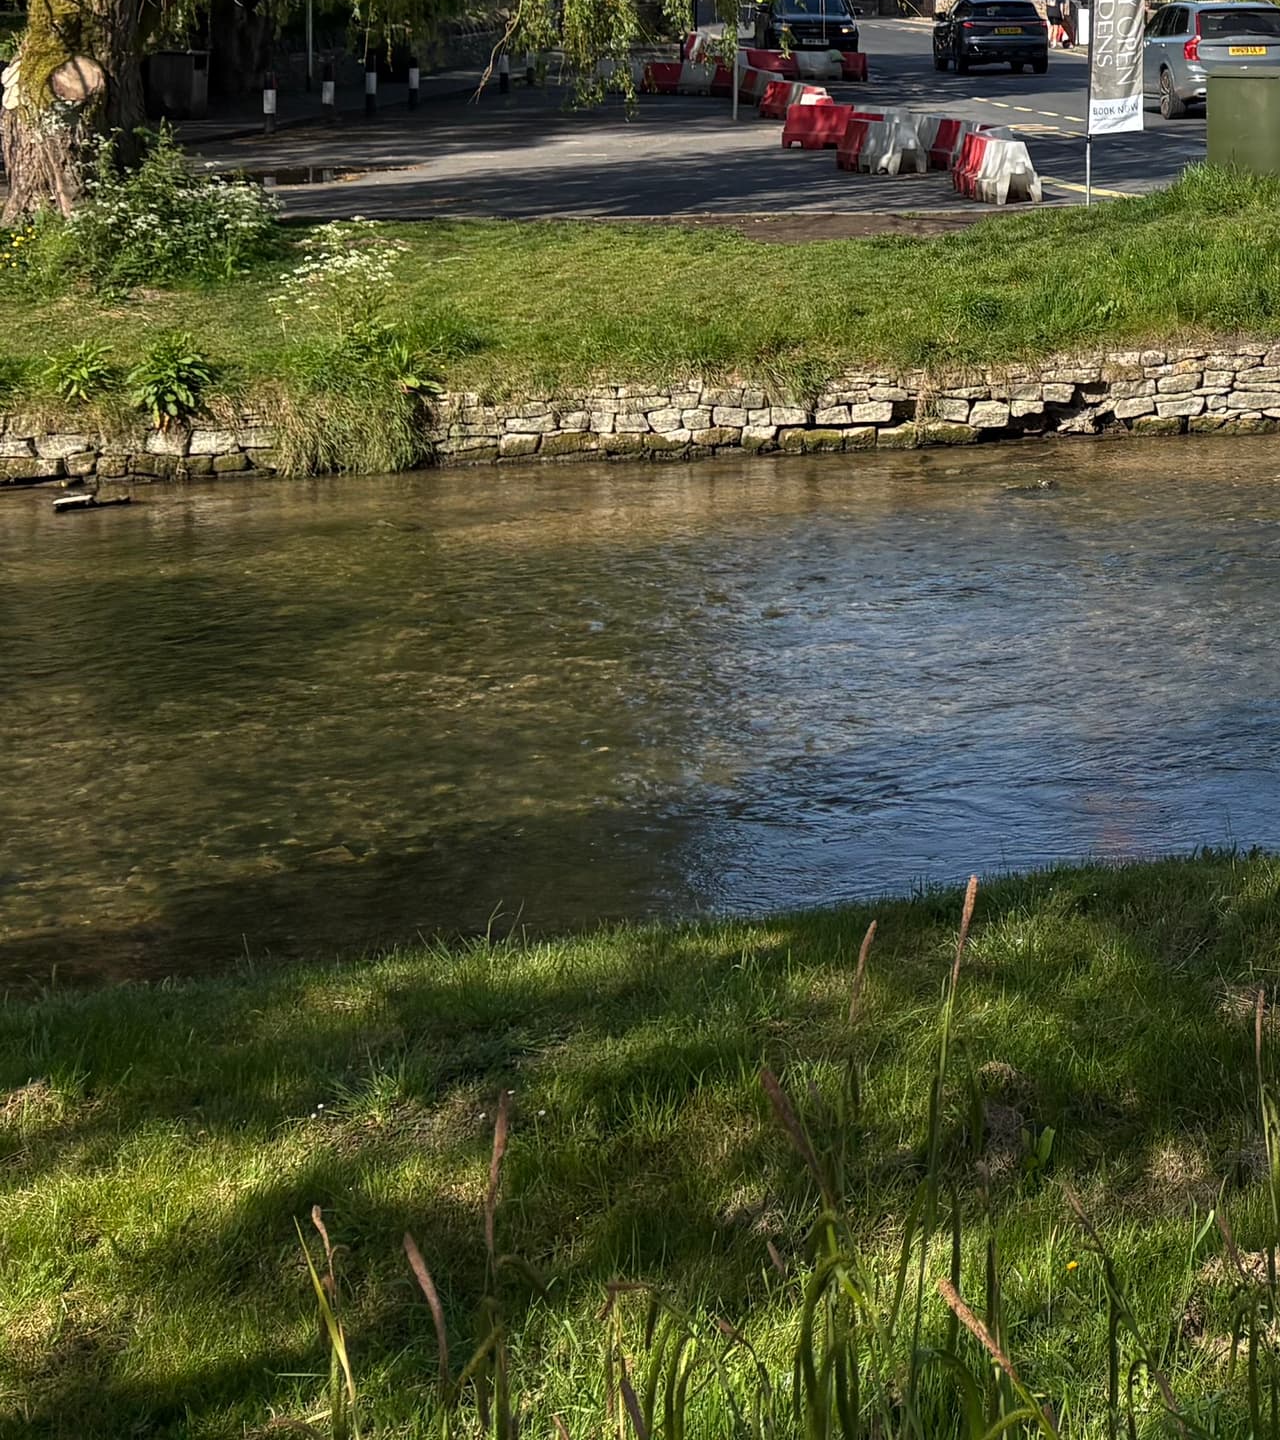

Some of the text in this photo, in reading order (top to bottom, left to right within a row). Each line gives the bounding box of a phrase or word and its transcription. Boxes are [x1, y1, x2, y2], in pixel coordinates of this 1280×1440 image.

[1116, 16, 1138, 86] OPEN
[1092, 103, 1138, 116] BOOK NOW
